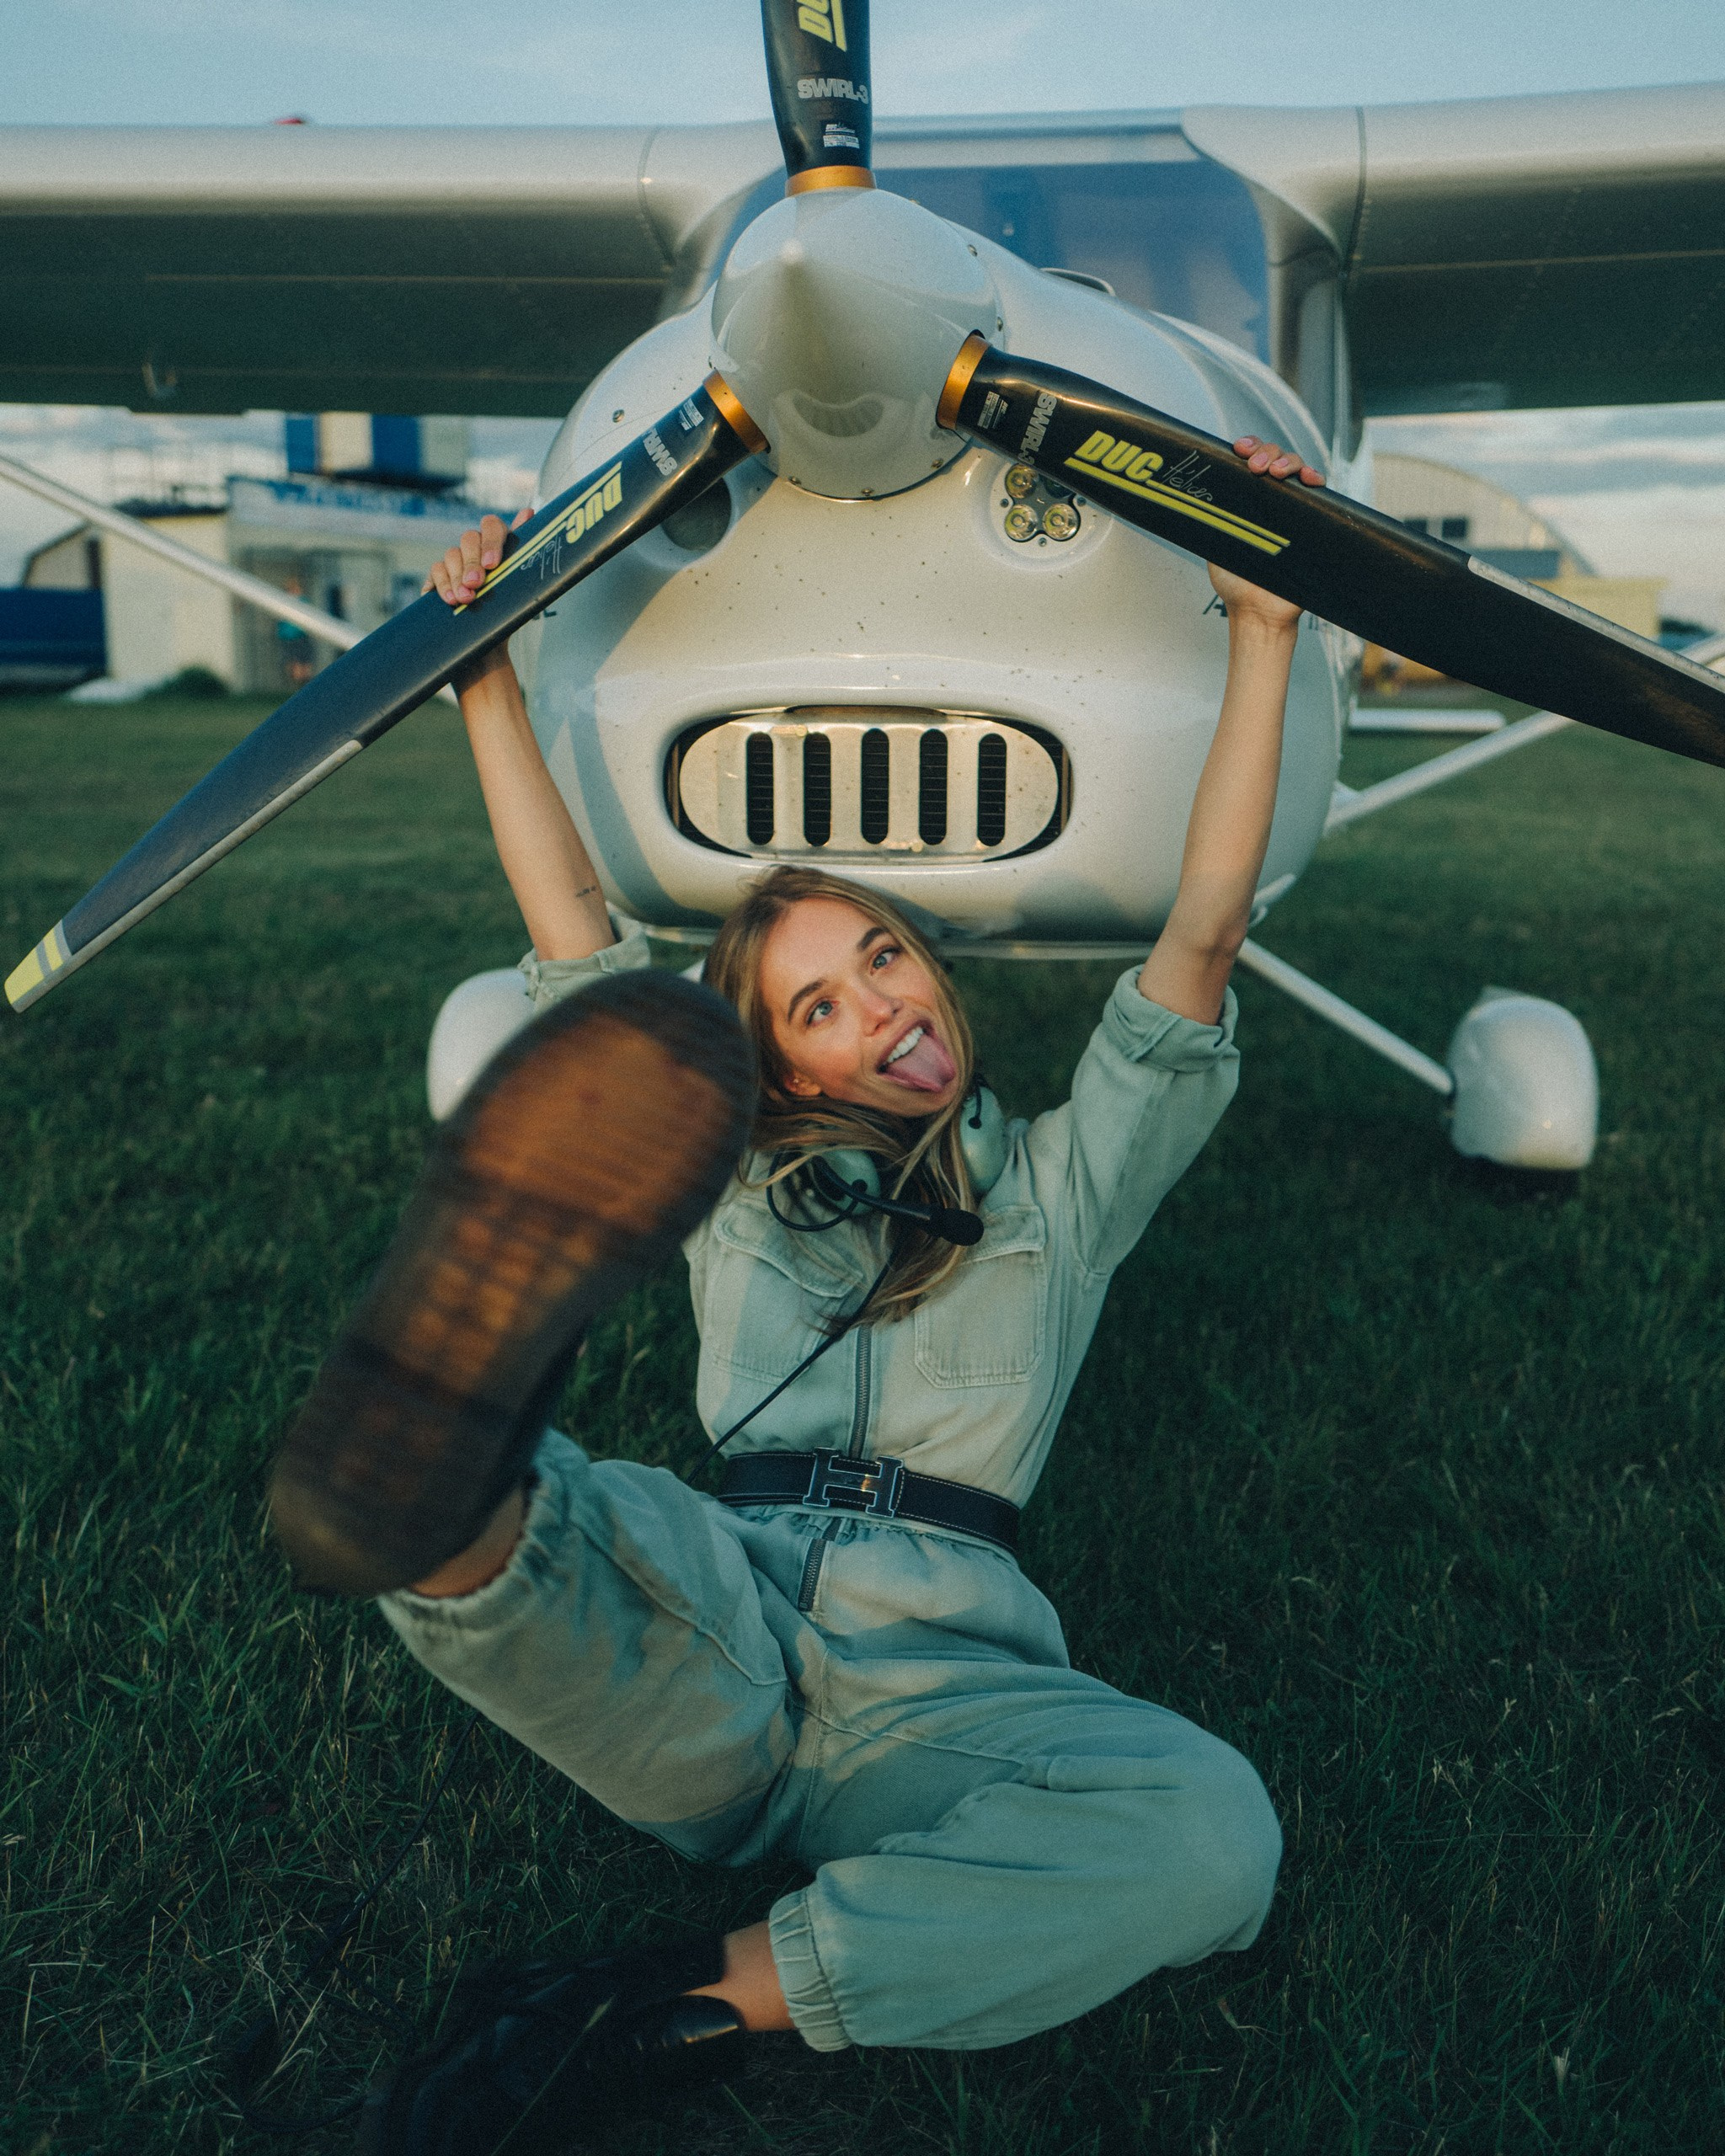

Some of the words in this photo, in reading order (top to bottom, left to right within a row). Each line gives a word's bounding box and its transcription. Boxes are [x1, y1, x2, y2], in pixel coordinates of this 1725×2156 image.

[797, 78, 868, 104] SWIRL-3
[1017, 392, 1058, 465] SWIRL-3
[1074, 430, 1164, 483] DUC
[565, 472, 623, 544] DUC
